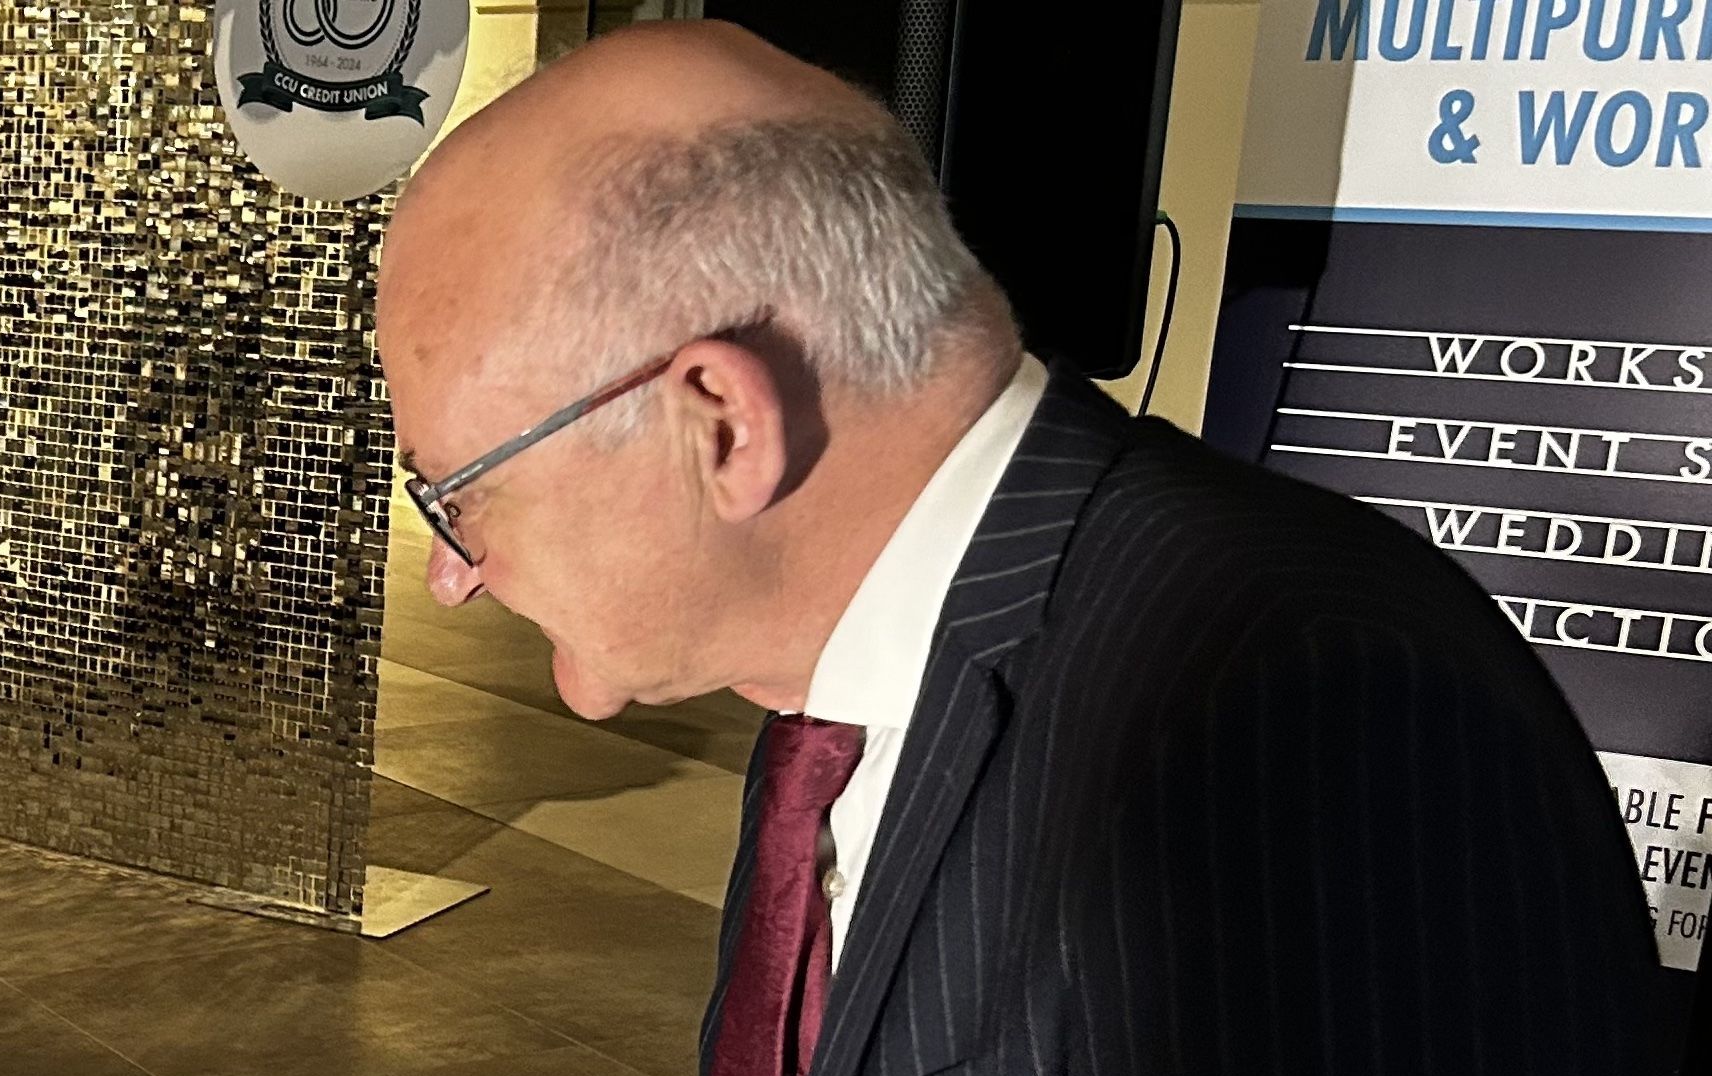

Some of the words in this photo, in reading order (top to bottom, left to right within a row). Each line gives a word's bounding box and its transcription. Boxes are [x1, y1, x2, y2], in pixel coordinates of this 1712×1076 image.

[274, 72, 298, 93] CCU
[299, 84, 340, 104] CREDIT
[343, 81, 388, 103] UNION
[1428, 89, 1480, 164] &
[1519, 90, 1710, 168] WOR
[1429, 335, 1707, 392] WORKS
[1388, 417, 1631, 473] EVENT
[1613, 786, 1685, 832] BLE
